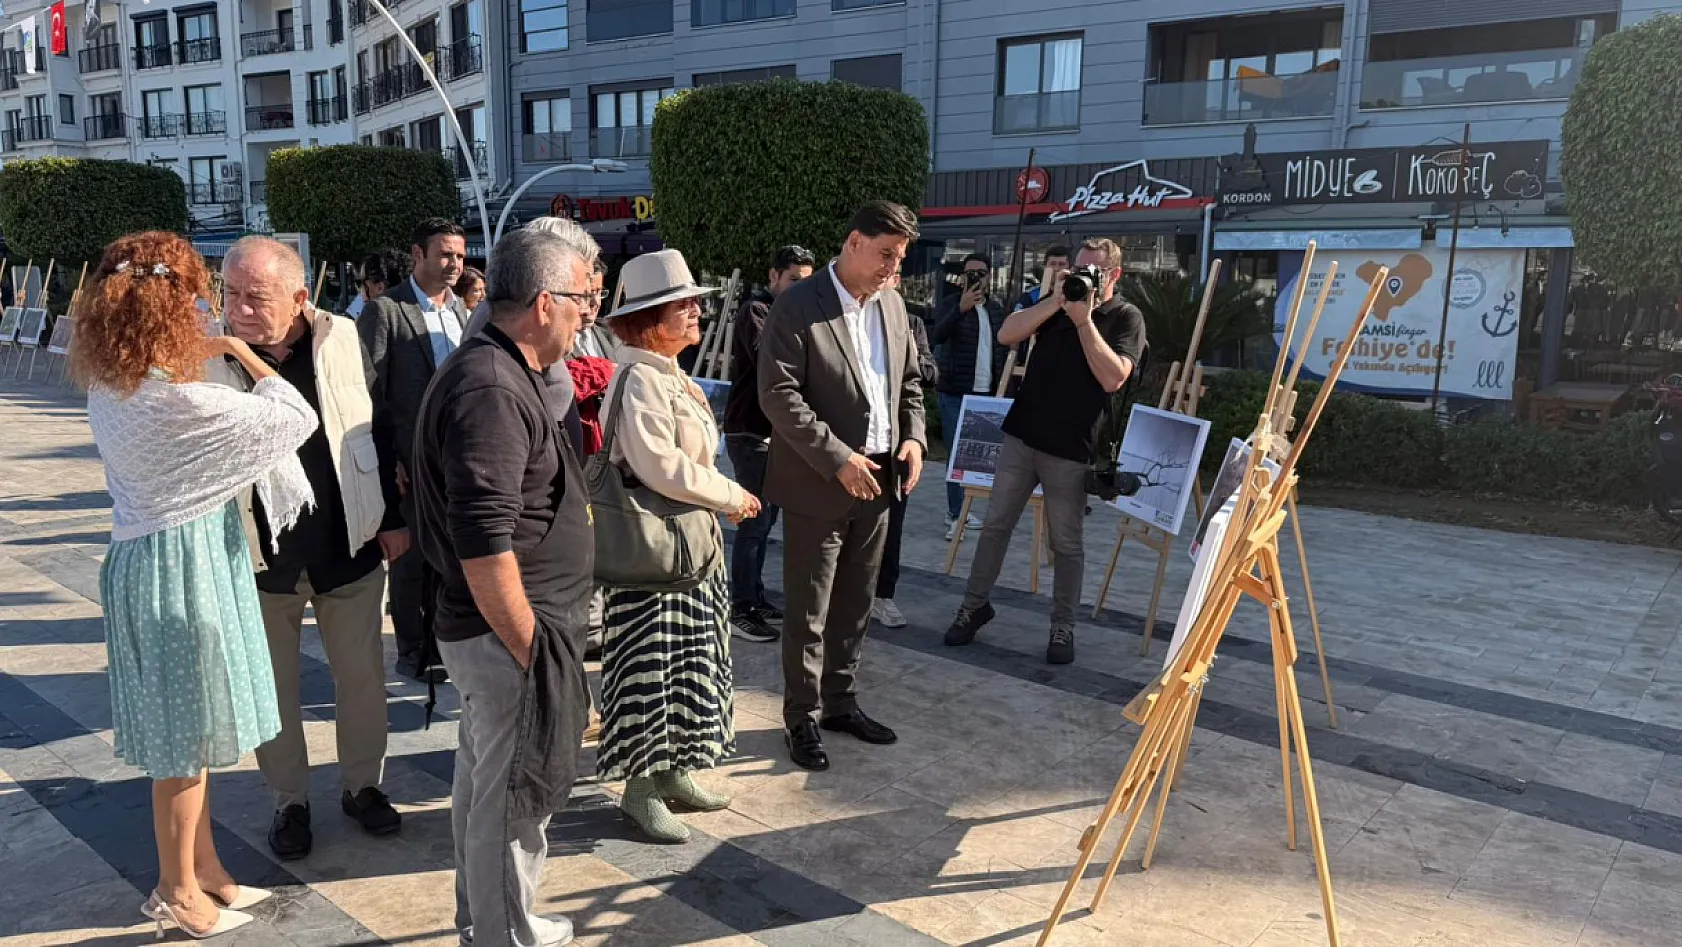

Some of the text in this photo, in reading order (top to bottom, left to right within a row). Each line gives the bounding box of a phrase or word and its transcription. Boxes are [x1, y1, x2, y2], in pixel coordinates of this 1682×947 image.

[577, 196, 633, 220] Tavuk
[1065, 185, 1172, 211] Pizza Hut
[1223, 192, 1272, 204] KORDON
[1358, 321, 1396, 337] AMSİ
[1322, 337, 1456, 361] Fhiye'de!
